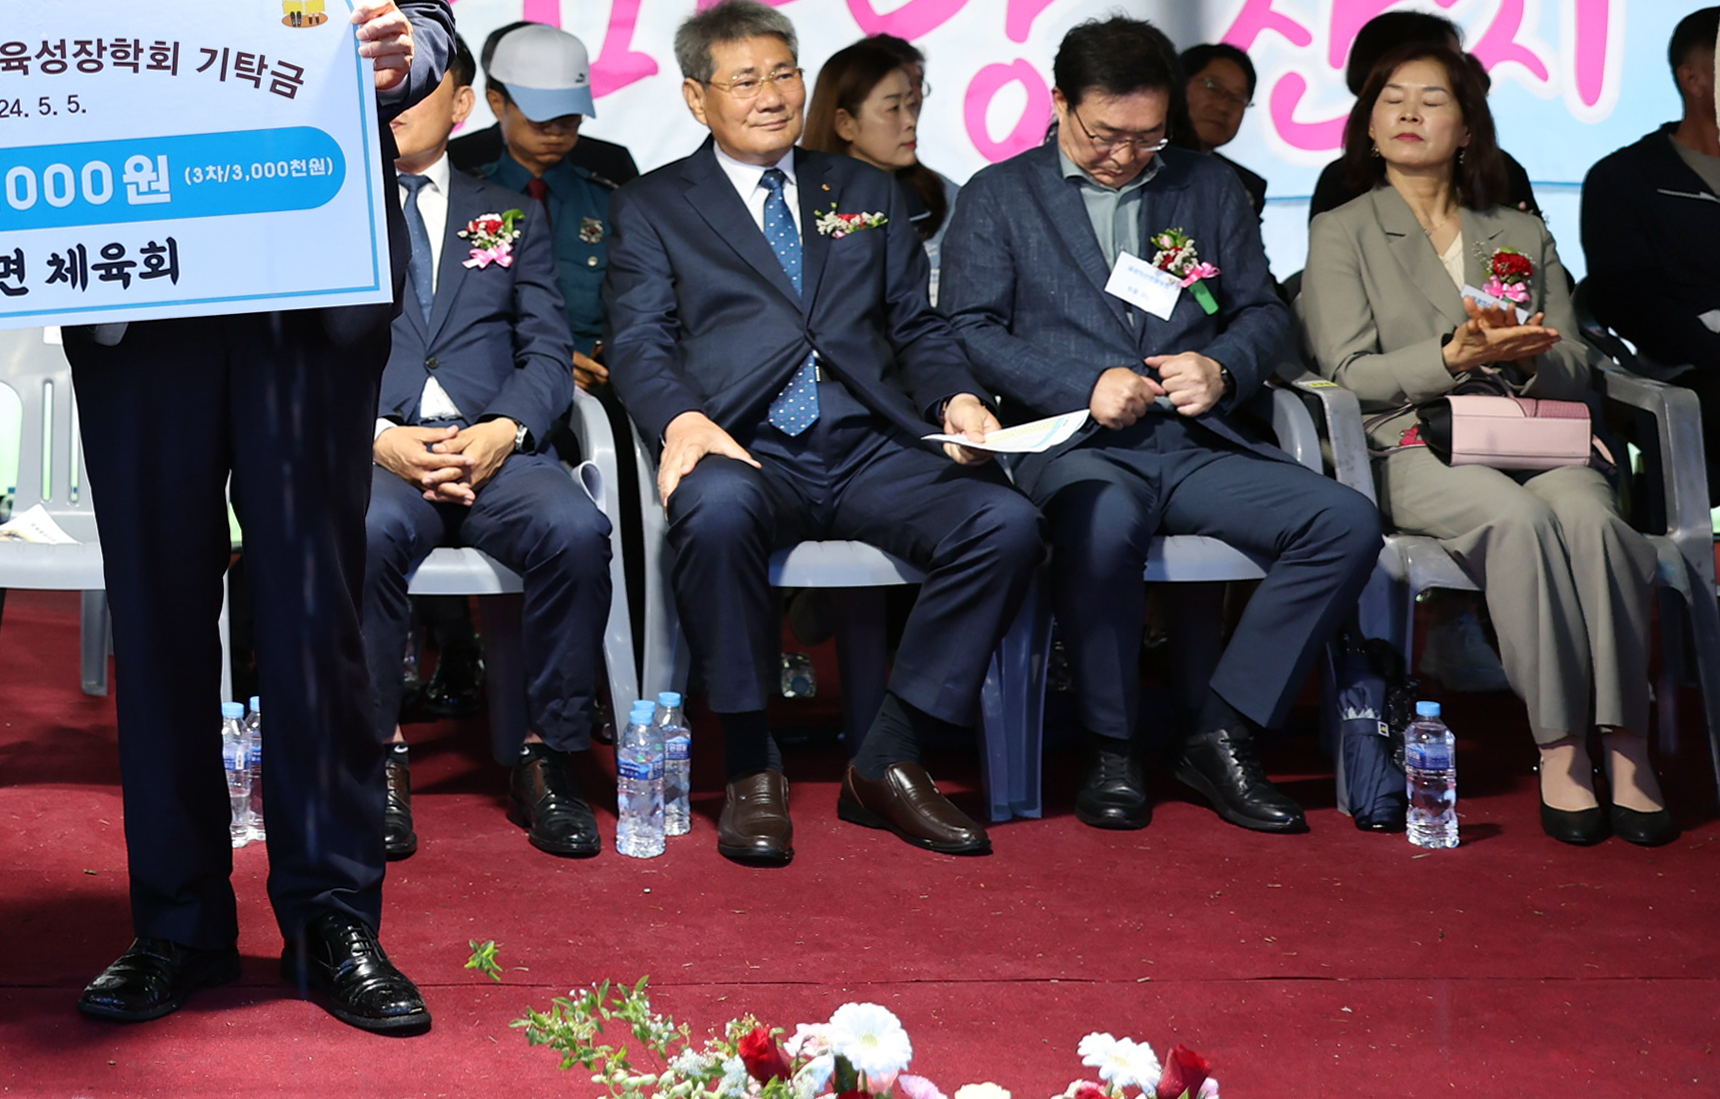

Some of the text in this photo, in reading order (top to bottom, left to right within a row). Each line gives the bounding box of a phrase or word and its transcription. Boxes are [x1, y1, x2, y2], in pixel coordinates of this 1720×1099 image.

[196, 46, 305, 100] 기탁금
[38, 96, 58, 117] 5.
[67, 94, 87, 115] 5.
[184, 156, 334, 186] (3차/3,000천원)
[45, 236, 180, 293] 체육회
